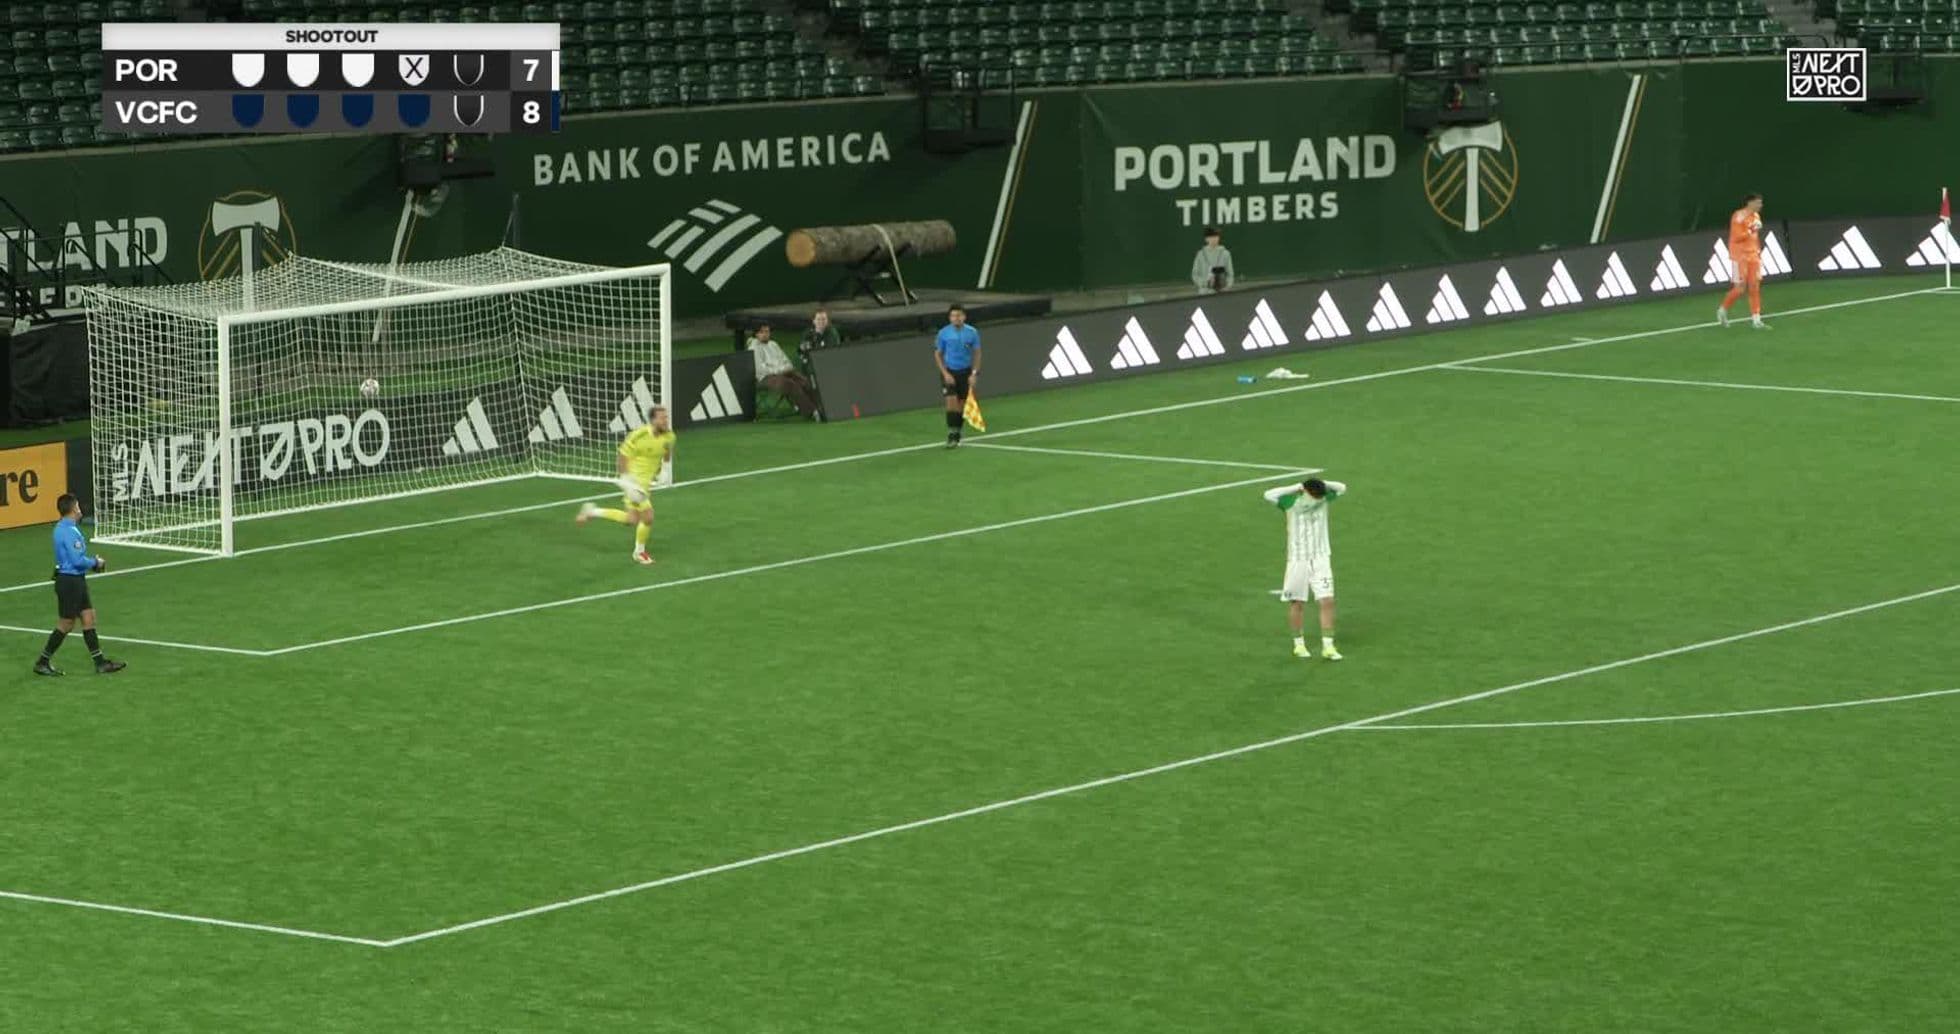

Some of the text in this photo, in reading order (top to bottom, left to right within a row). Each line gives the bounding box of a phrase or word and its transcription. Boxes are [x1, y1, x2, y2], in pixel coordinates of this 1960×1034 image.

[533, 131, 891, 186] BANK OF AMERICA
[1114, 134, 1397, 192] PORTLAND
[1176, 192, 1339, 227] TIMBERS
[131, 426, 252, 499] NEXT
[298, 409, 390, 475] PRO
